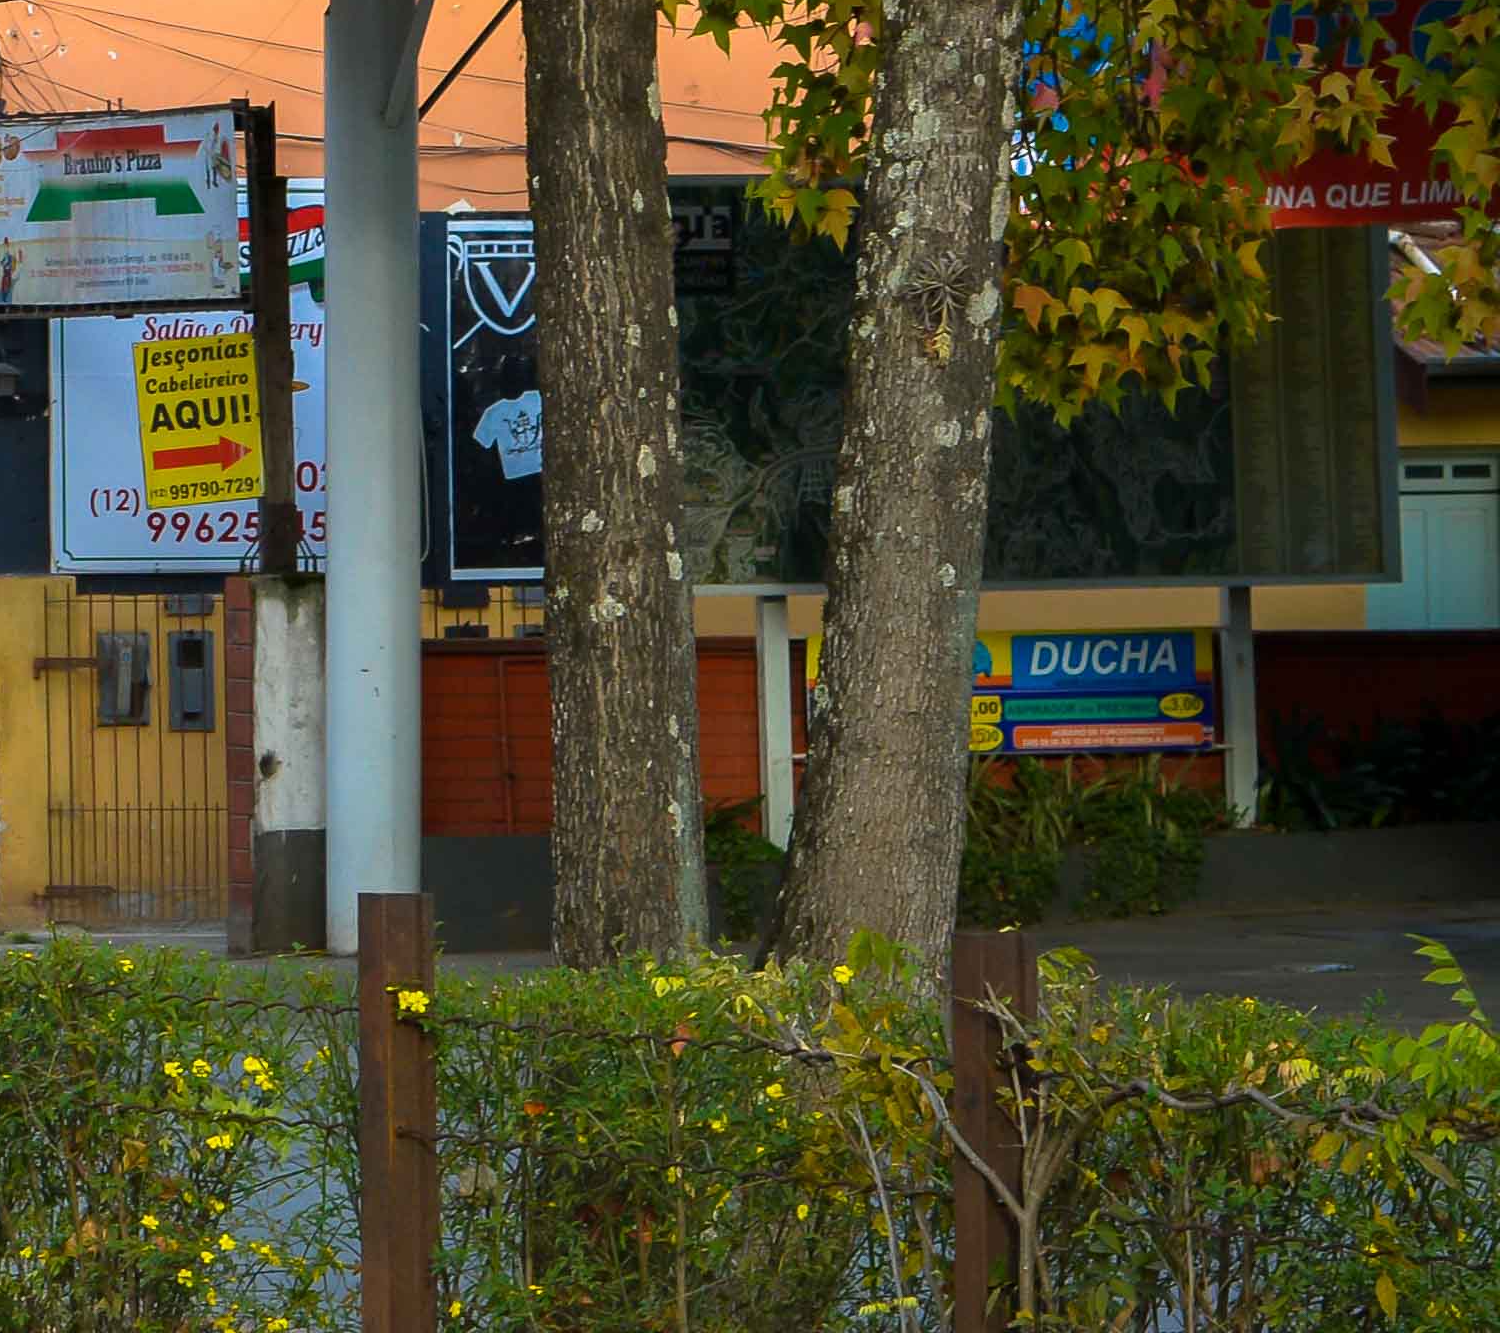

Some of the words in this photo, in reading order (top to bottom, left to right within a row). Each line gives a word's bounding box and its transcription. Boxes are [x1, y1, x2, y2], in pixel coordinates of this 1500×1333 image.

[126, 148, 162, 172] Pizza
[1325, 182, 1391, 209] QUE
[145, 371, 249, 395] Cabeleireiro
[149, 394, 253, 433] AQUI!
[90, 488, 141, 517] (12)
[1029, 638, 1178, 676] DUCHA
